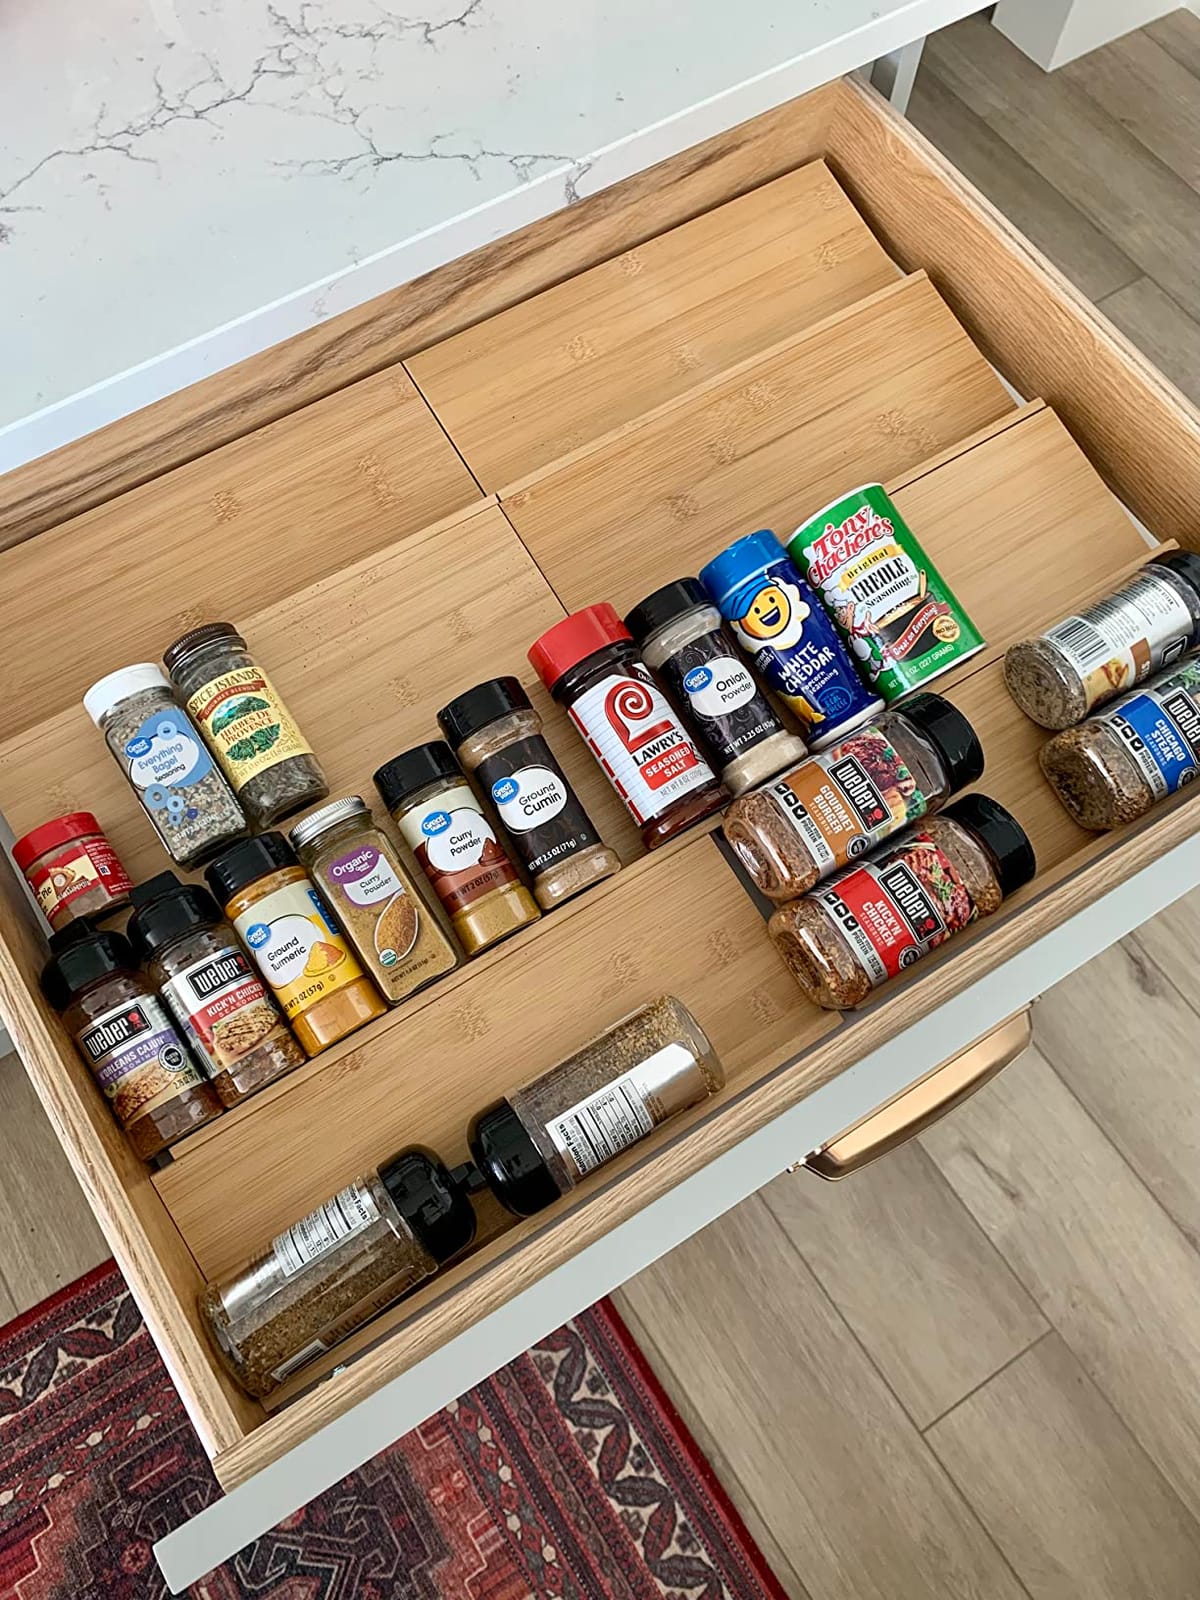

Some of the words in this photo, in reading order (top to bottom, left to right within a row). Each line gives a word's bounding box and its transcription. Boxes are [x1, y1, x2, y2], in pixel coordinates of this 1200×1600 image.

[848, 548, 889, 579] Original
[850, 557, 909, 602] CREOLE
[865, 576, 911, 609] Seasoning
[778, 641, 818, 681] WHITE
[785, 646, 836, 693] CHEDDAR
[715, 671, 747, 693] Onion
[720, 681, 753, 703] Powder
[188, 686, 215, 715] SPICE
[220, 716, 256, 740] HERBES
[224, 717, 274, 746] PROVENCE
[1155, 719, 1186, 761] CHICAGO
[137, 742, 183, 770] Everything
[631, 730, 684, 767] LAWRY'S
[1150, 730, 1175, 761] STEAK
[152, 755, 179, 774] Bagel
[154, 763, 186, 782] Seasoning
[645, 744, 690, 778] SEASONED
[664, 759, 687, 778] SALT
[518, 782, 556, 806] Ground
[836, 763, 878, 810] weber
[522, 792, 562, 816] Cumin
[813, 795, 844, 835] BURGER
[819, 784, 855, 832] GOURMET
[449, 830, 473, 846] Curry
[450, 836, 482, 857] Powder
[332, 850, 373, 877] Organic
[41, 886, 53, 900] Pie
[359, 873, 381, 889] Curry
[363, 876, 392, 897] Powder
[887, 871, 930, 923] weber
[861, 901, 896, 947] CHICKEN
[874, 900, 903, 937] KICK'N
[267, 936, 300, 962] Ground
[270, 945, 307, 973] Turmeric
[193, 958, 243, 993] weber
[299, 991, 308, 1001] OZ
[307, 981, 324, 998] (57g)
[207, 996, 236, 1017] KICK'N
[86, 1017, 131, 1057] weber
[137, 1036, 164, 1056] CAJUN
[558, 1123, 574, 1147] Facts
